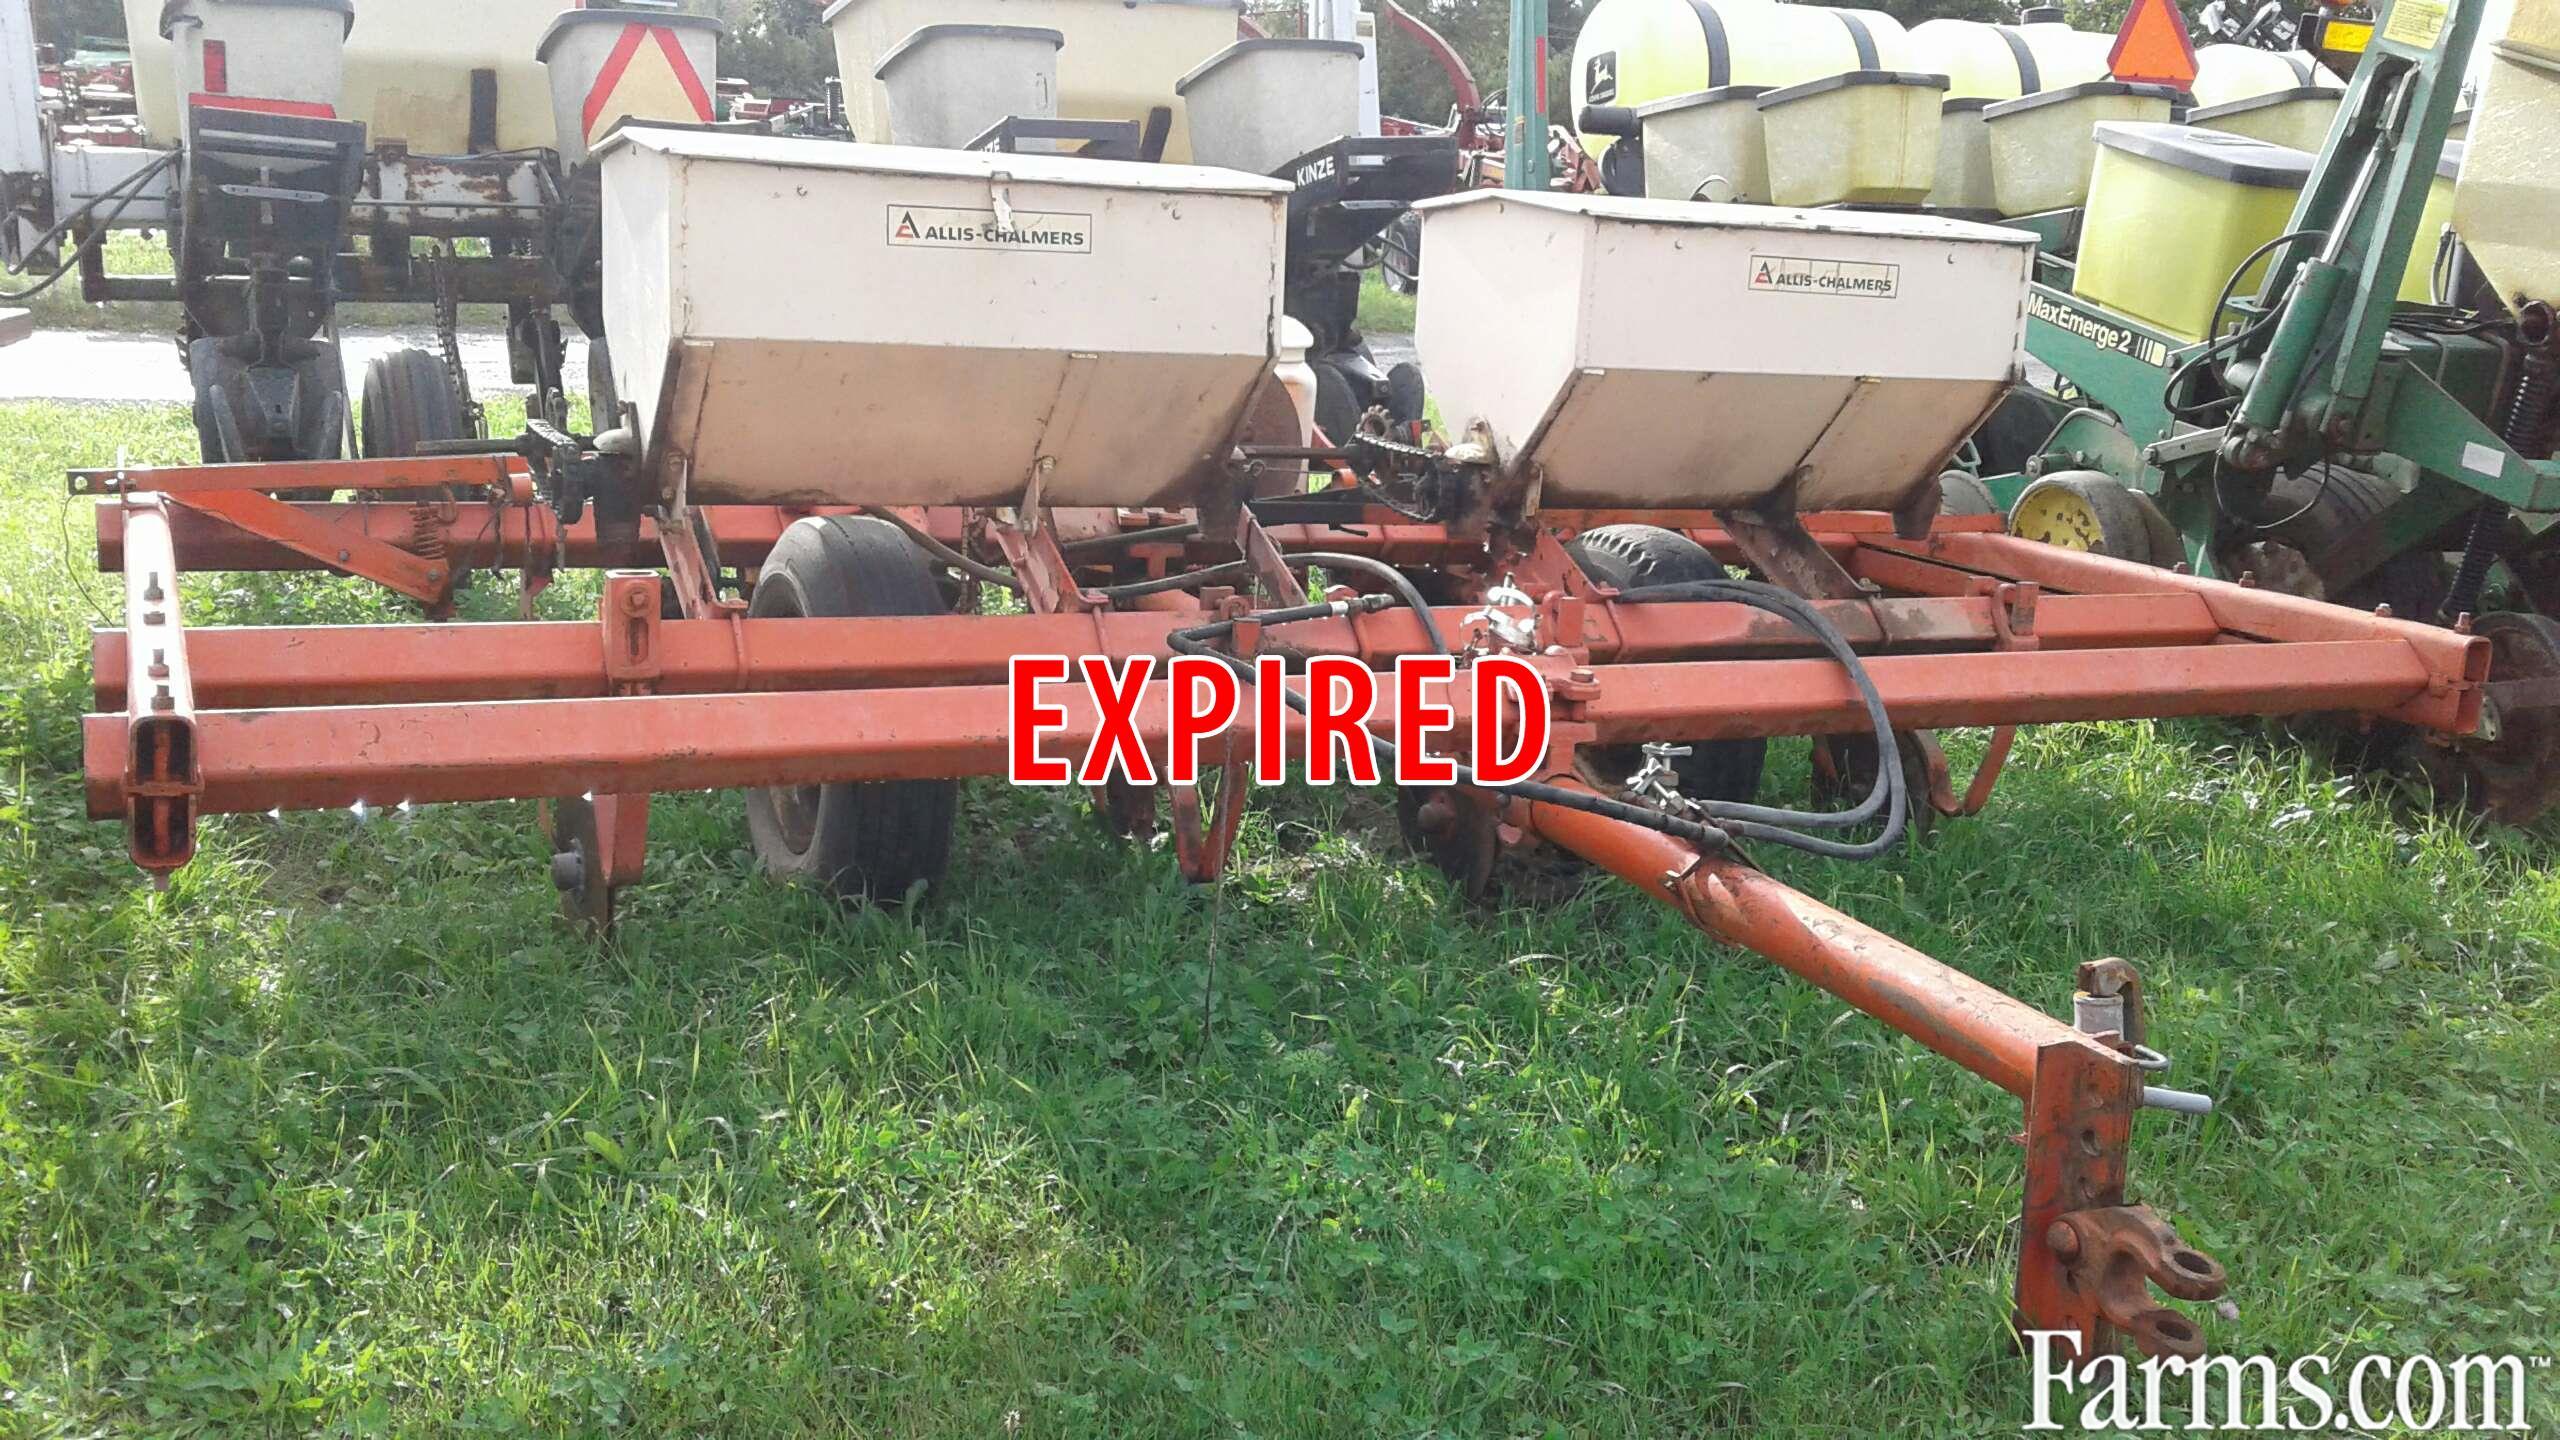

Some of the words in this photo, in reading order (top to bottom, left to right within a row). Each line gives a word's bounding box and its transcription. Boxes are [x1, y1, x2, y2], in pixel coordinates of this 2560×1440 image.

[1296, 156, 1336, 186] KINZE
[925, 226, 1084, 246] ALLIS-CHALMERS
[1775, 272, 1892, 292] ALLIS-CHALMERS
